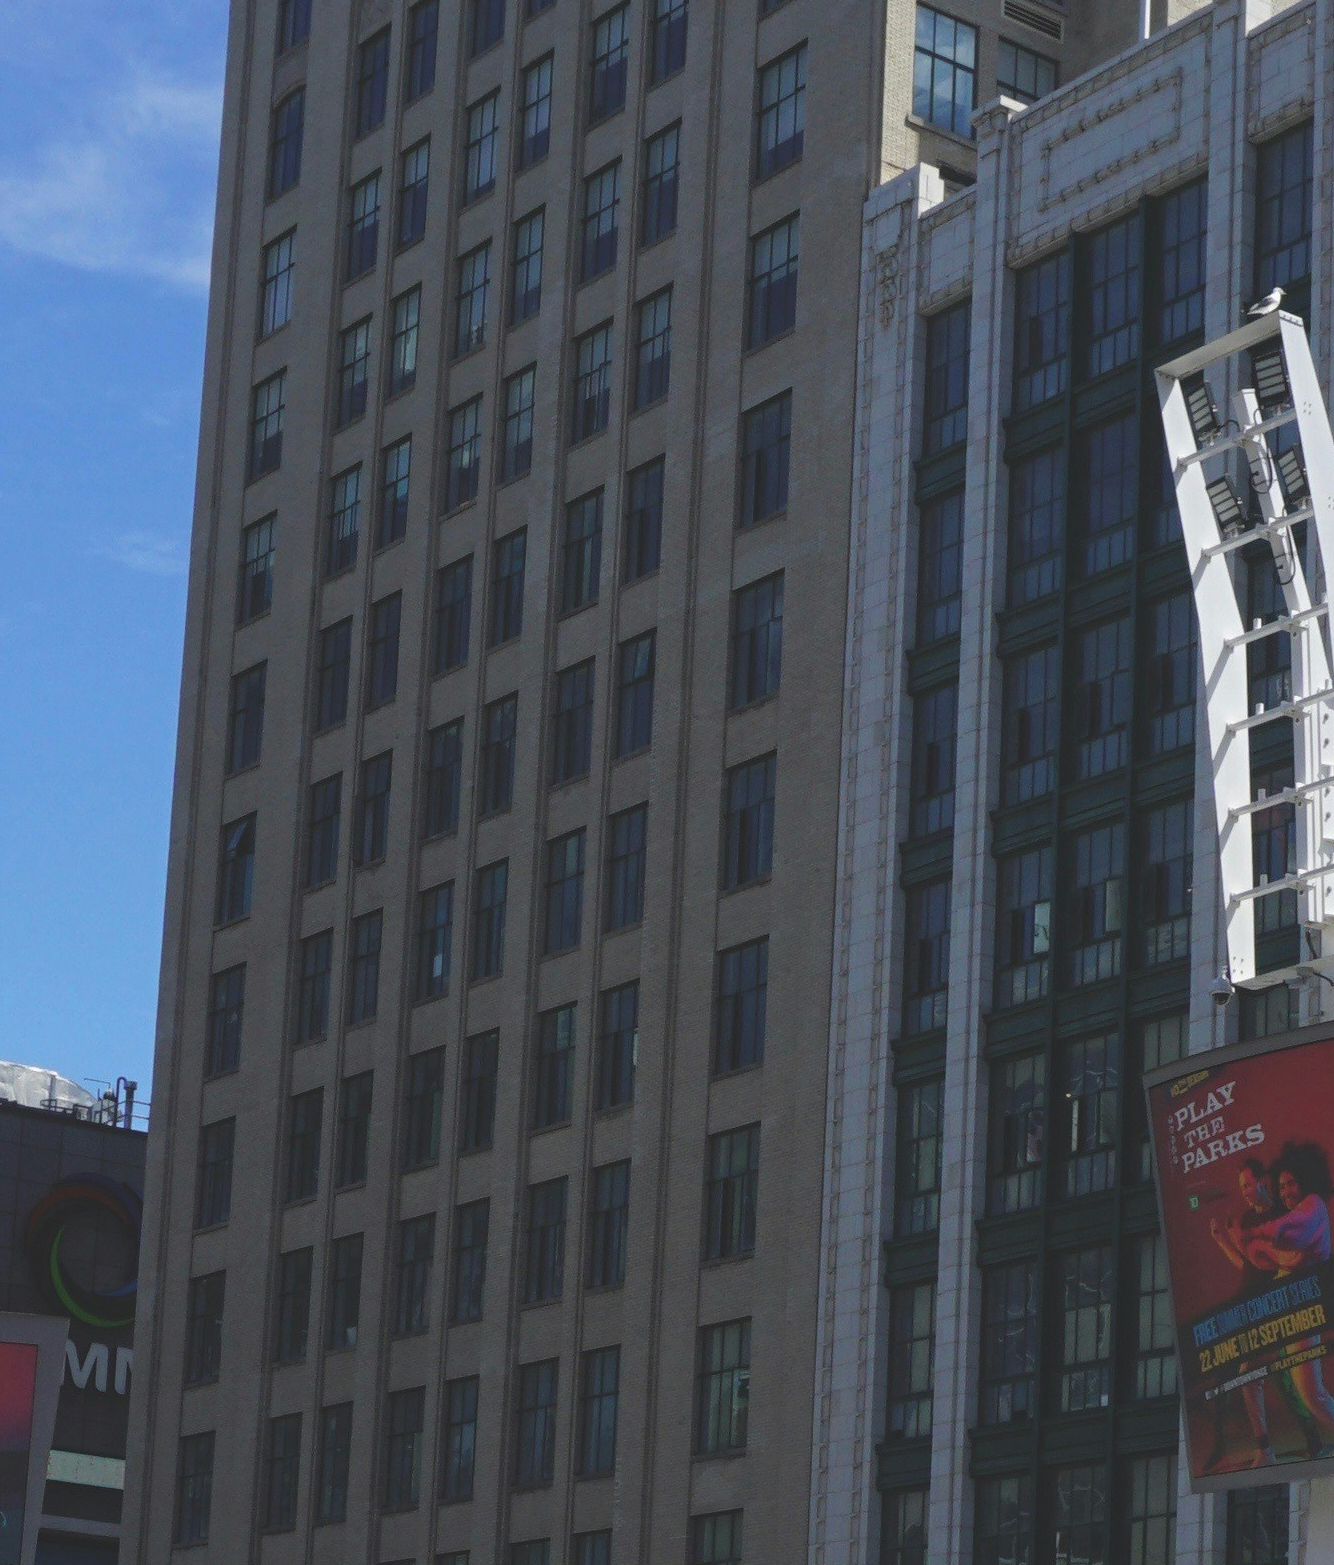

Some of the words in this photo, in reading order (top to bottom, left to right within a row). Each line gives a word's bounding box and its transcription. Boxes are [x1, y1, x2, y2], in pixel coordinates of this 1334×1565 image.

[1174, 1081, 1236, 1131] PLAY
[1181, 1123, 1265, 1174] PARKS
[1184, 1116, 1225, 1148] THE
[1199, 1349, 1213, 1373] 22
[1213, 1336, 1240, 1367] JUNE
[1259, 1304, 1327, 1346] SEPTEMBER
